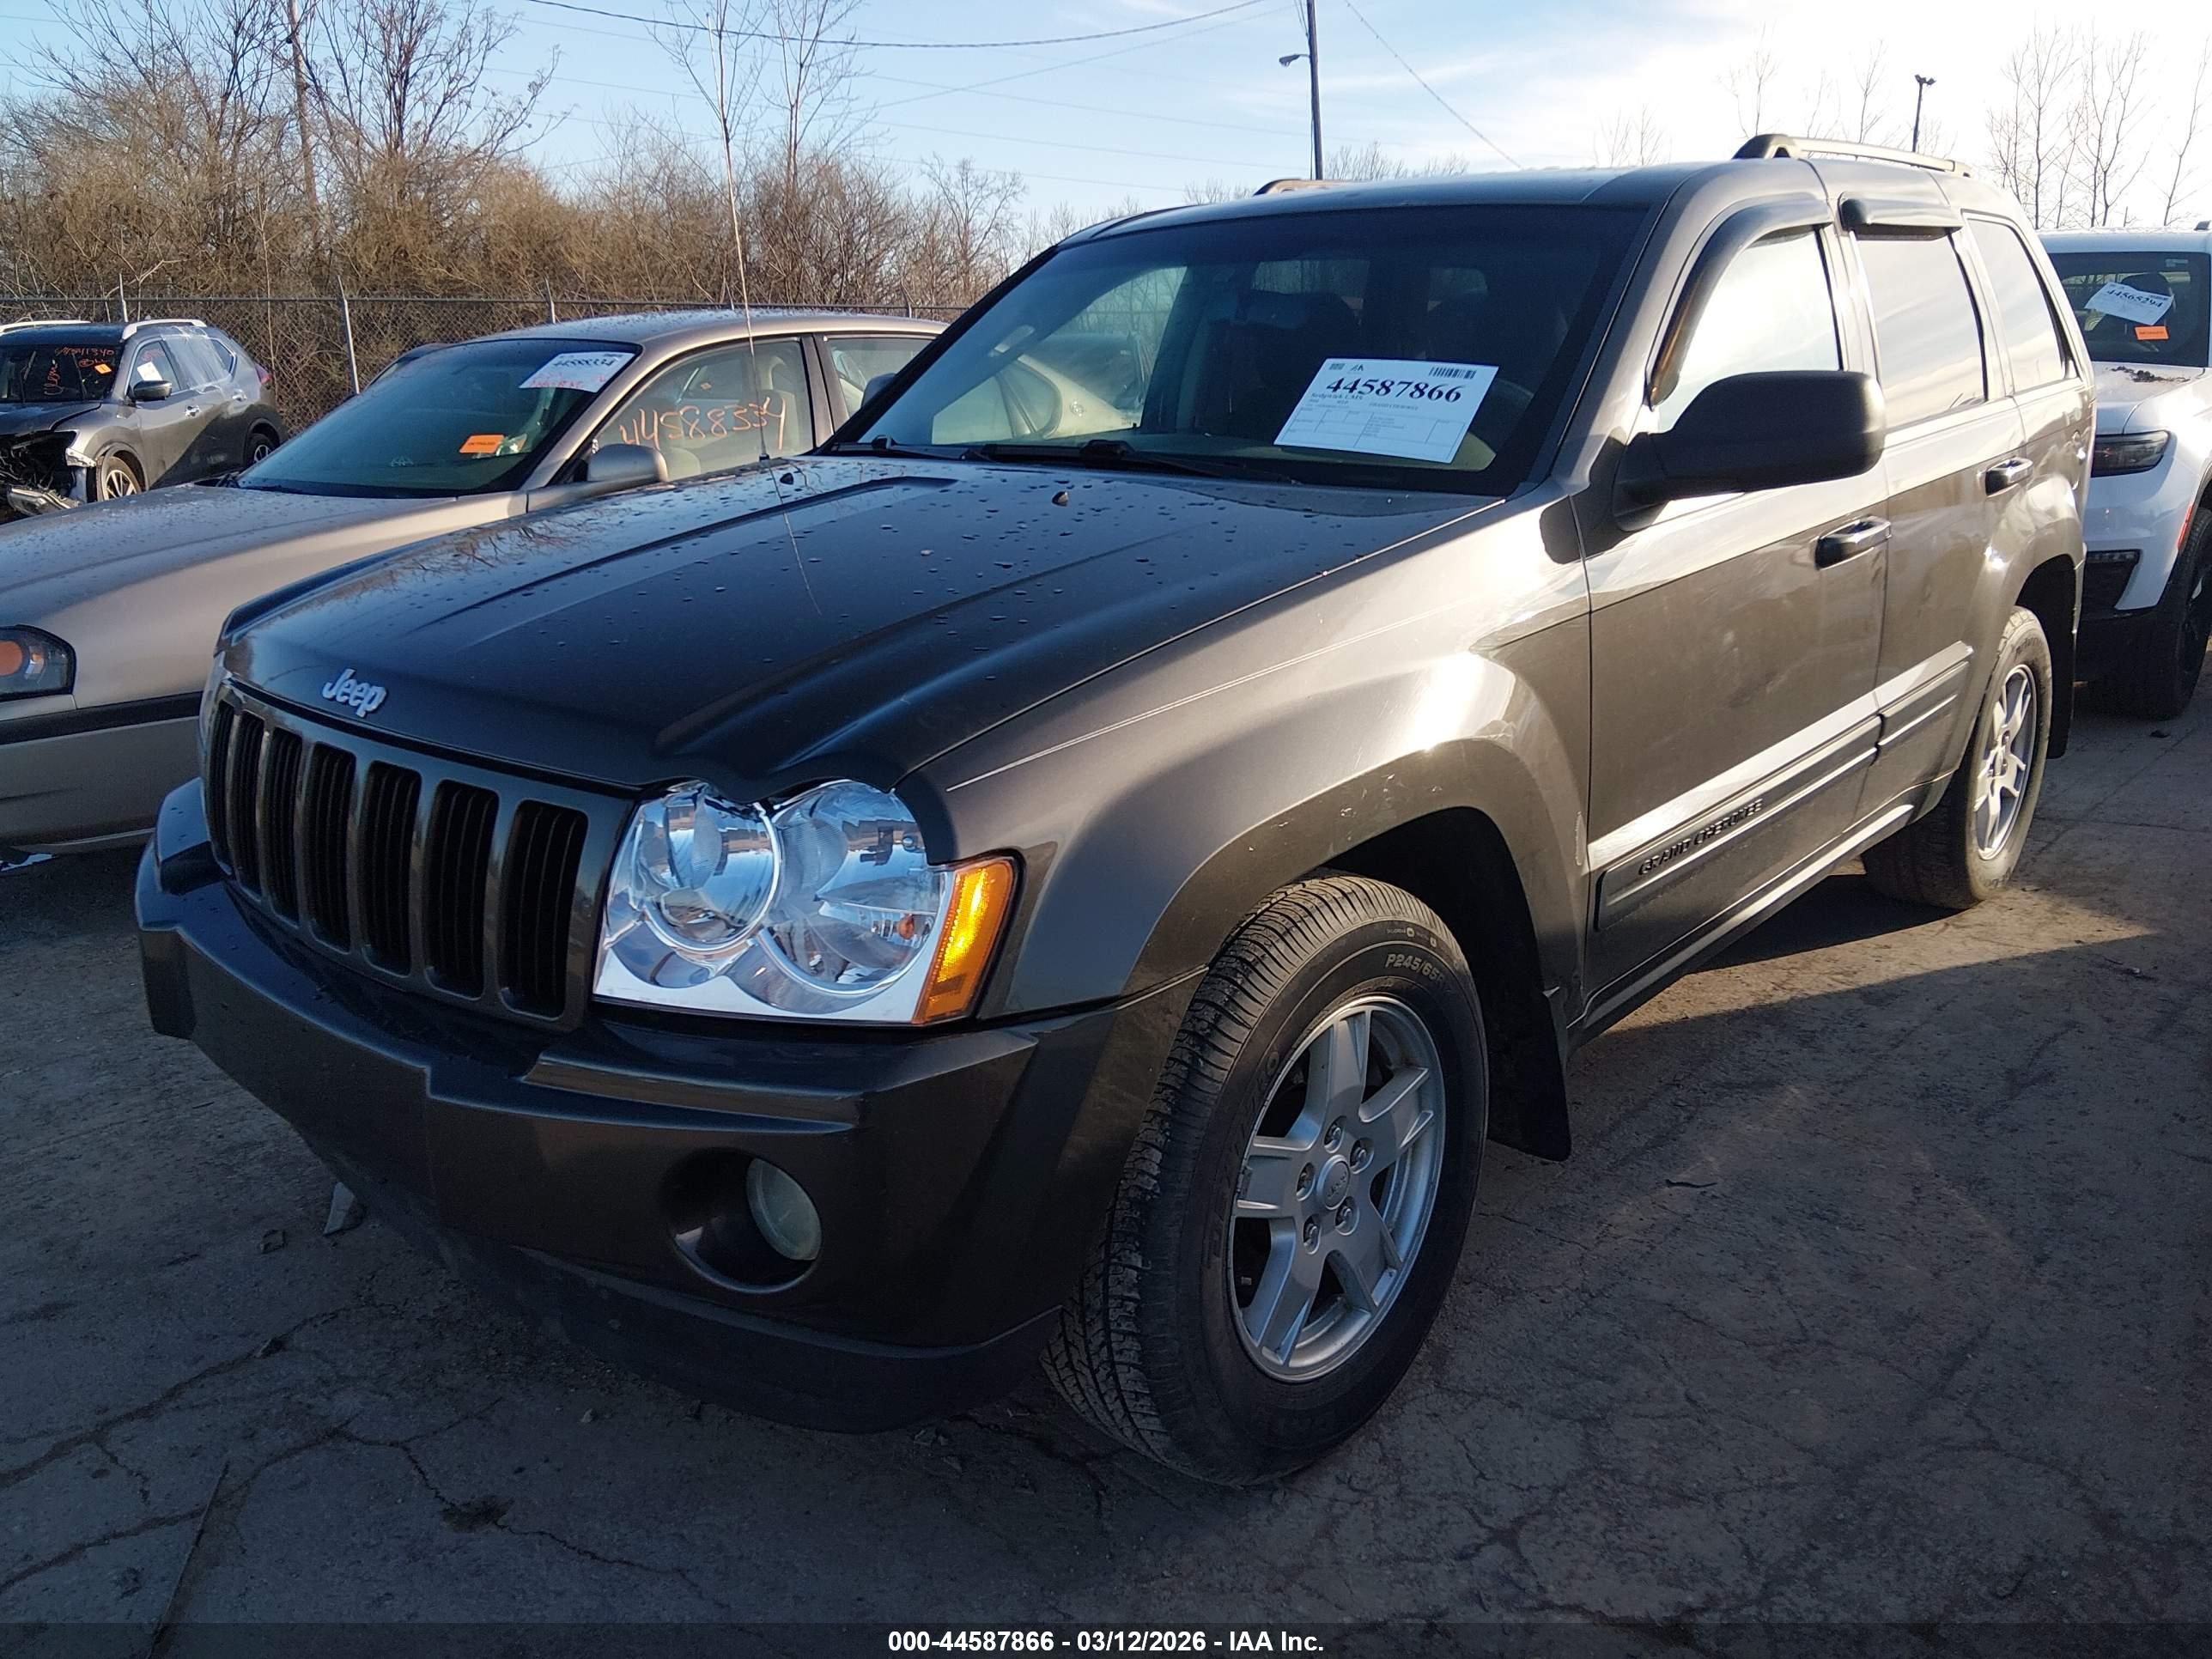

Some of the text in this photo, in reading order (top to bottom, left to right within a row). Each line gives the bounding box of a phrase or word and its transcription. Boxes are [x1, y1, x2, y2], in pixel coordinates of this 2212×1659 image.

[1326, 377, 1465, 404] 44587866
[322, 668, 387, 718] Jeep
[1638, 798, 1764, 876] GRAND CHEROKEE
